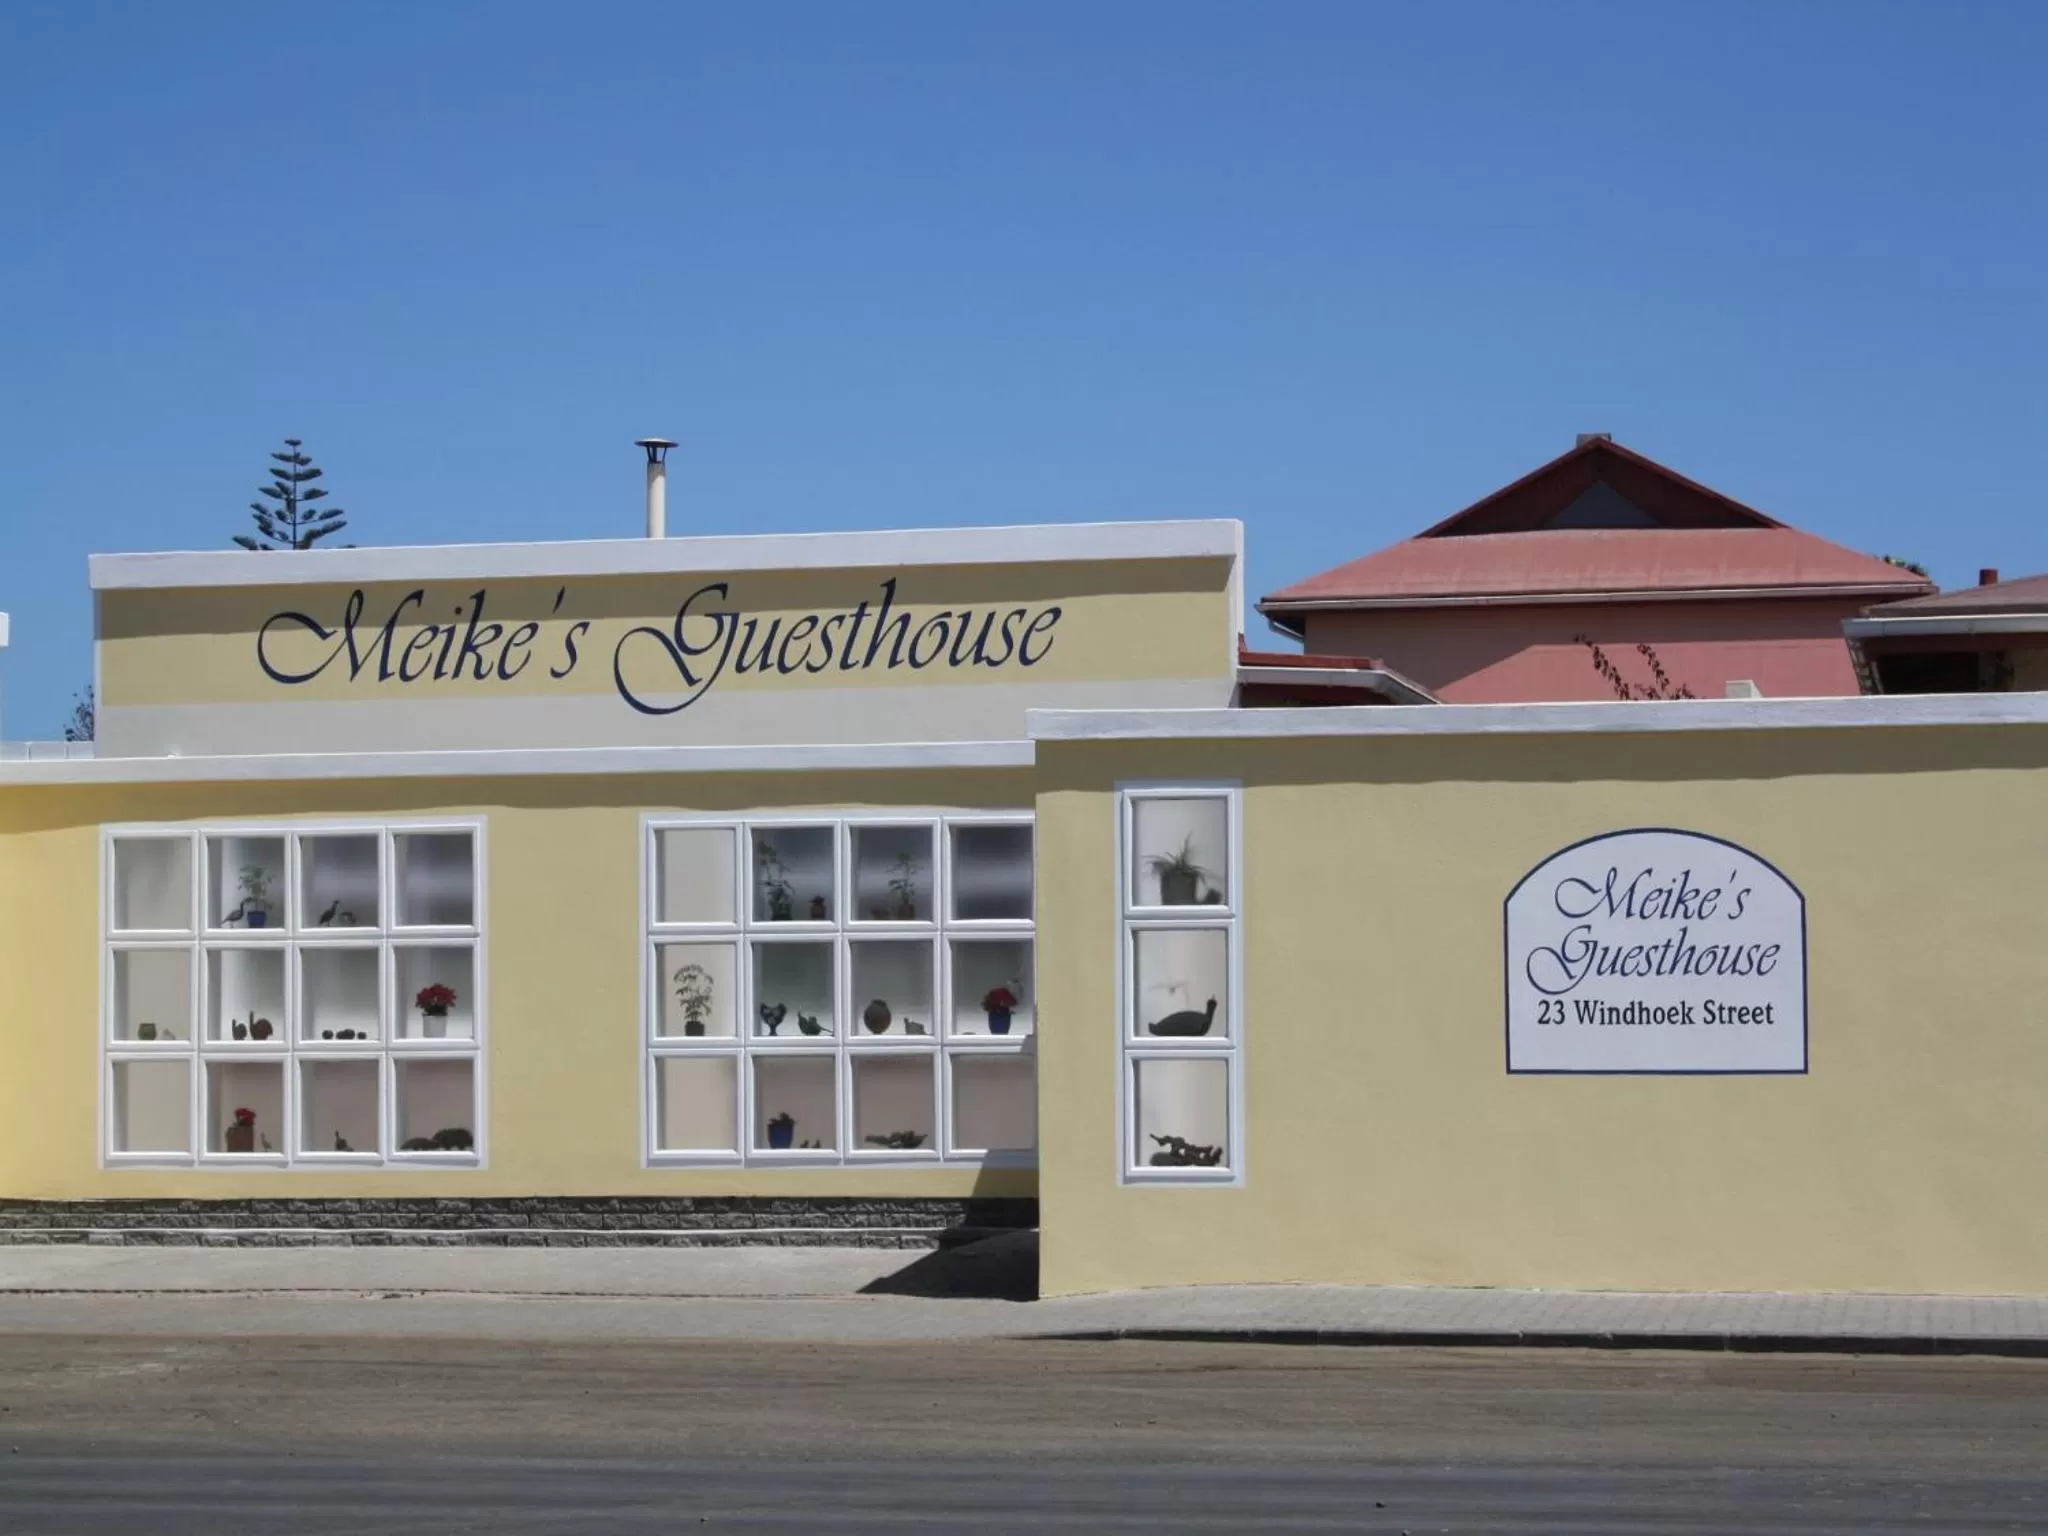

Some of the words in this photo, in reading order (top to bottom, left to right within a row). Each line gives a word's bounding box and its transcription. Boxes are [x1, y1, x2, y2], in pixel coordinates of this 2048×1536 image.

[258, 585, 590, 684] Meike's
[613, 576, 1062, 714] Guesthouse
[1554, 865, 1753, 921] Meike's
[1525, 924, 1782, 996] Guesthouse
[1536, 999, 1566, 1026] 23
[1572, 999, 1697, 1026] Windhoek
[1702, 998, 1775, 1026] Street
